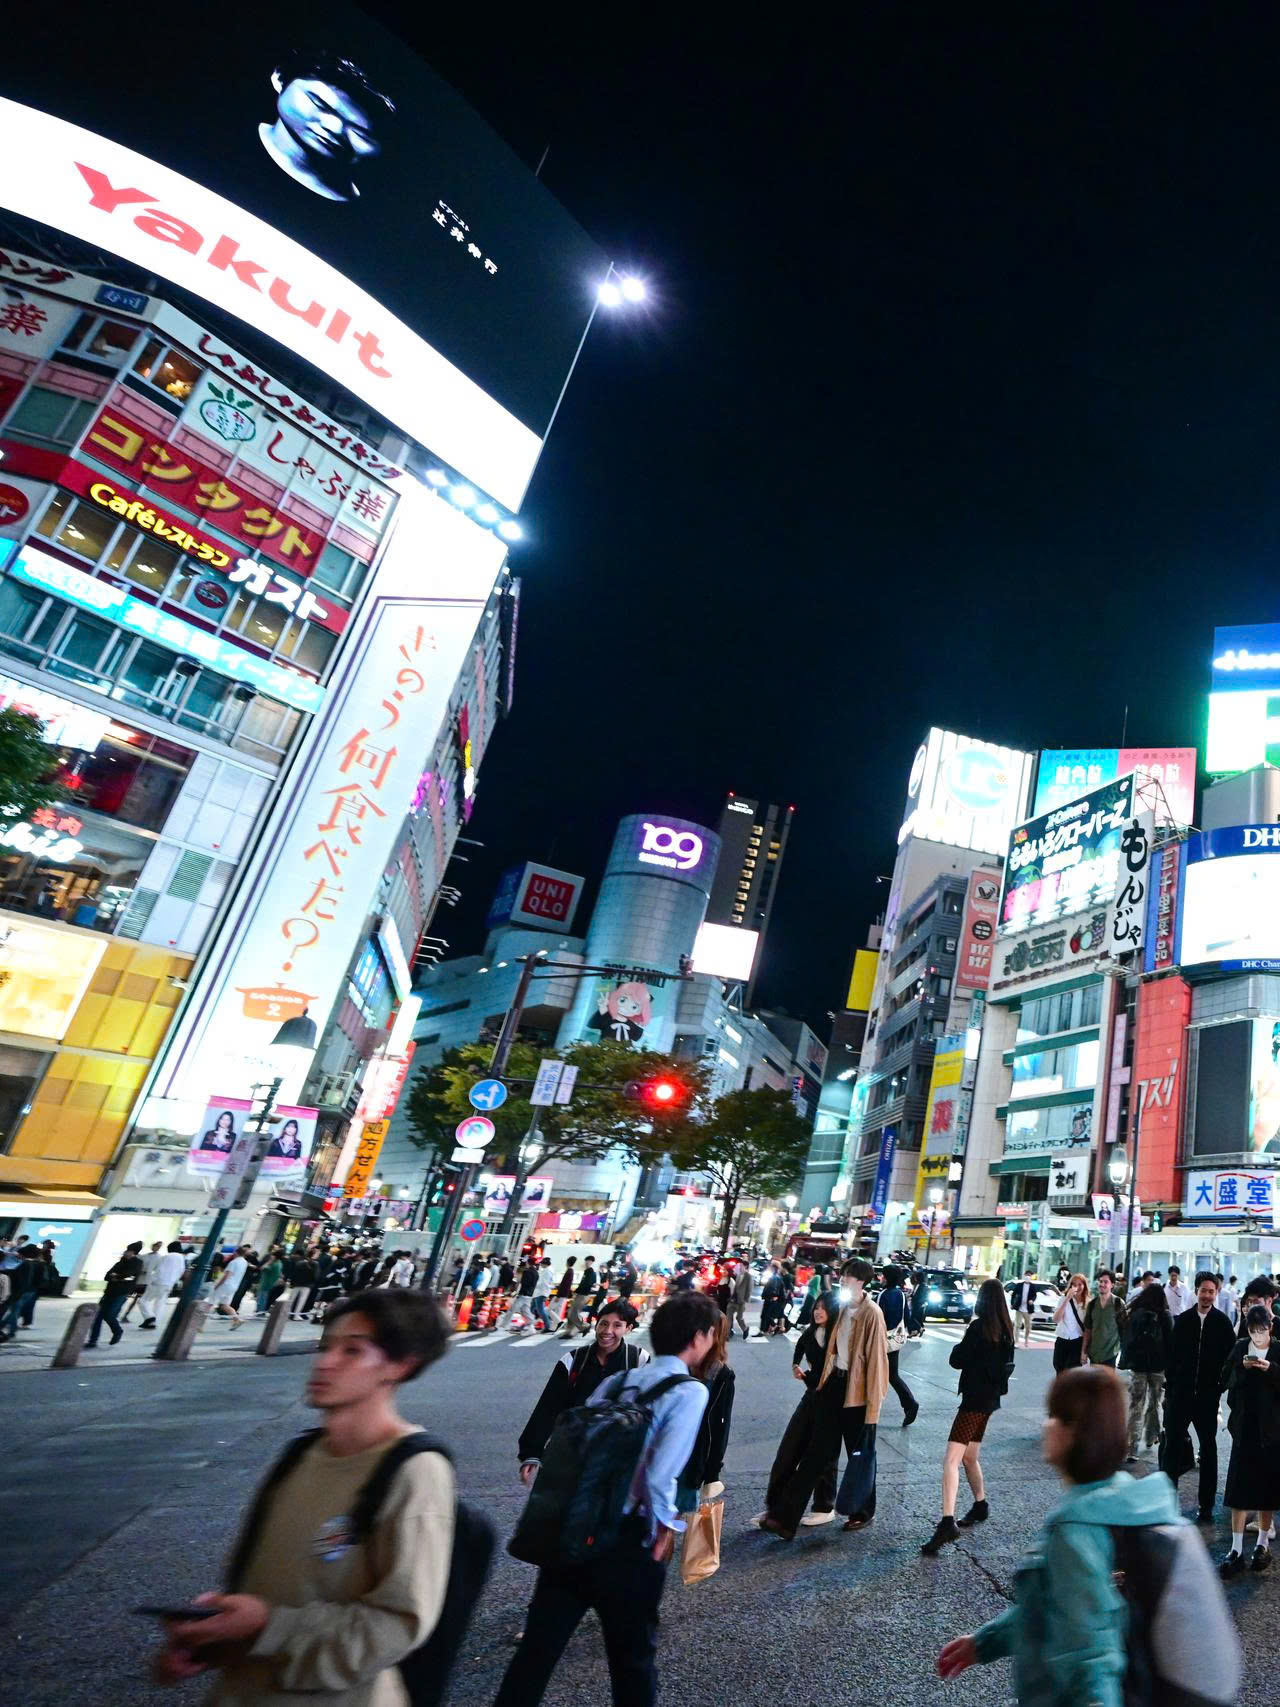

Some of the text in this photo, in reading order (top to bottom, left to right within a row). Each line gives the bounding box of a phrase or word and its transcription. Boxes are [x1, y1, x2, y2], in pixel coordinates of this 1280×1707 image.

[73, 161, 392, 379] Yakult
[90, 415, 314, 557] コンタクト
[267, 430, 387, 522] しゃぶ葉
[228, 557, 329, 620] ガスト
[642, 822, 703, 869] 109
[1113, 819, 1148, 946] もんじゃ
[528, 897, 563, 916] QLO
[534, 879, 566, 899] UNI
[1155, 849, 1175, 962] 三千里薬品
[1242, 961, 1260, 969] DHC
